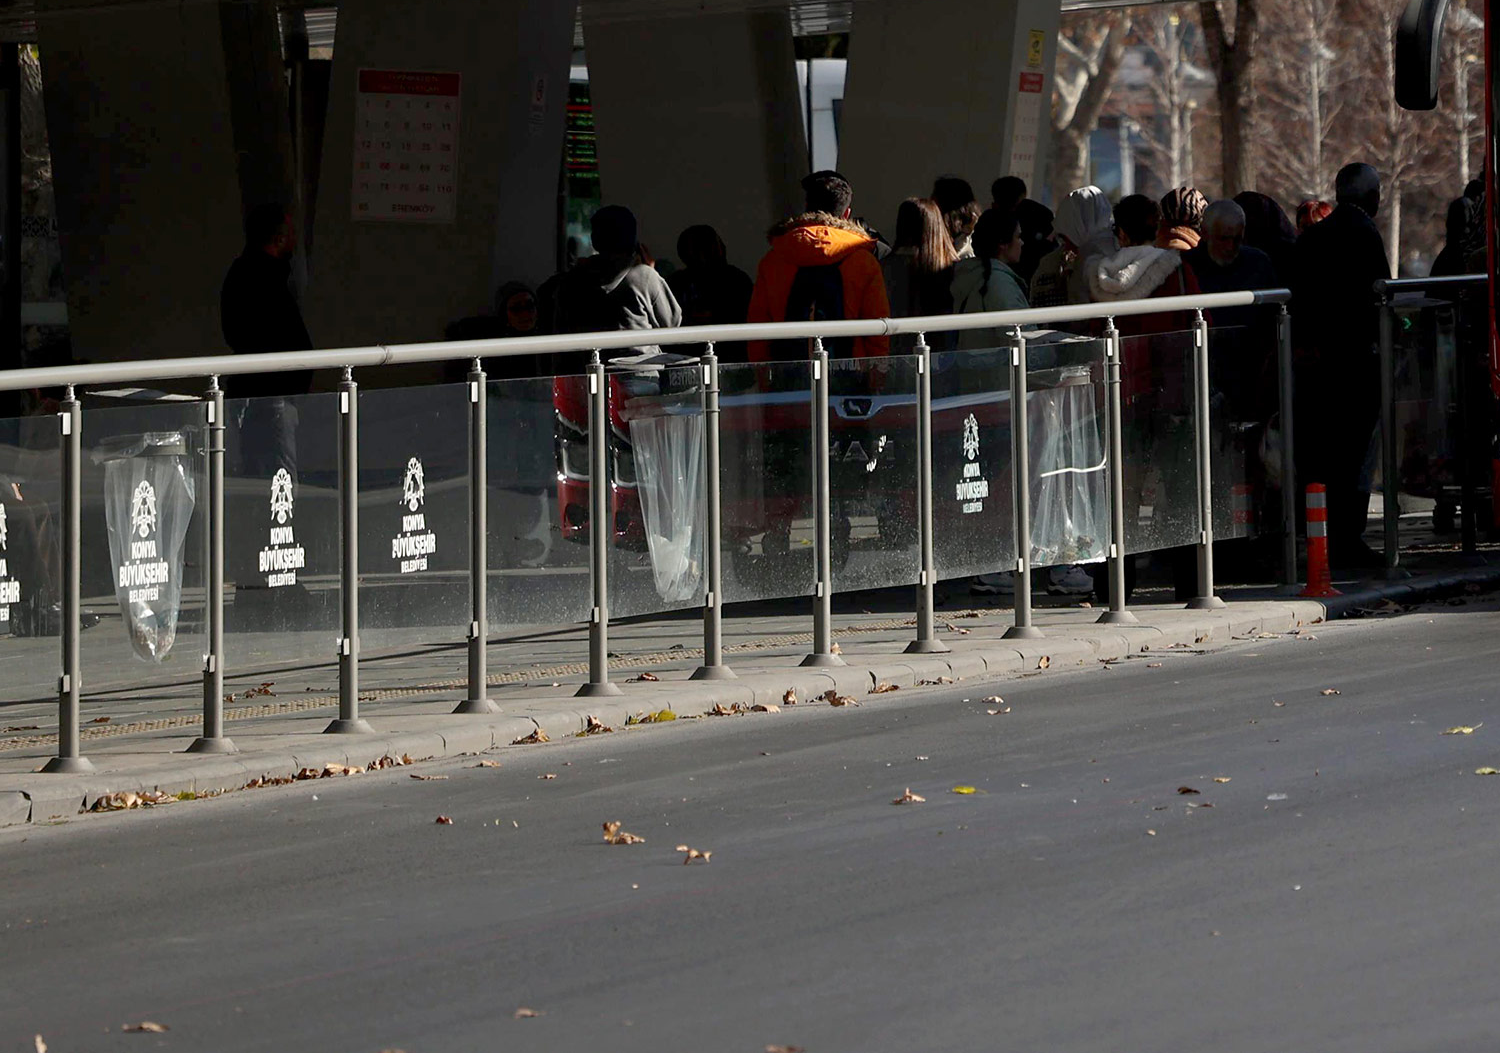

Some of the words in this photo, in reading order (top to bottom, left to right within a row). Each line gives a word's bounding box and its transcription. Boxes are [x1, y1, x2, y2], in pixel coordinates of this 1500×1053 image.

[402, 514, 425, 532] KONYA
[270, 526, 294, 546] KONYA
[392, 529, 437, 559] BÜYÜKŞEHİR
[131, 540, 157, 559] KONYA
[259, 543, 306, 574] BÜYÜKŞEHİR
[119, 557, 169, 588] BÜYÜKŞEHİR
[129, 585, 159, 604] BELEDİYESİ
